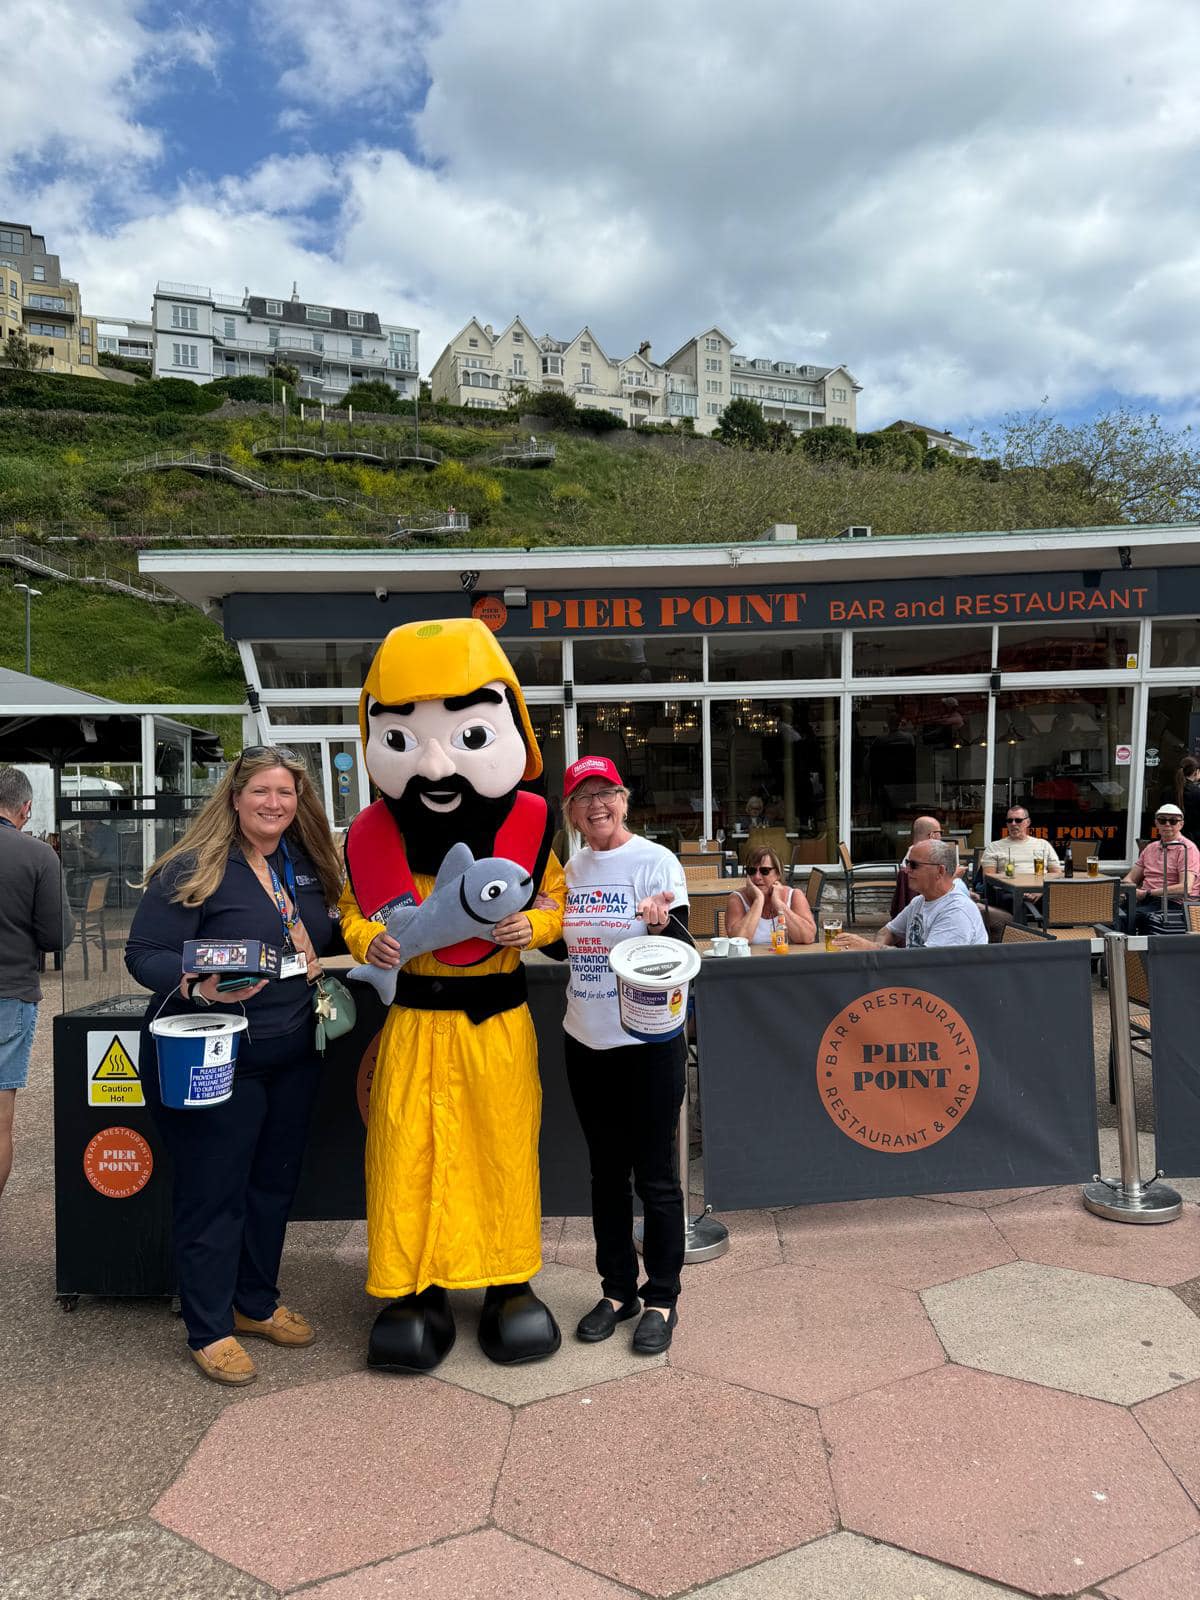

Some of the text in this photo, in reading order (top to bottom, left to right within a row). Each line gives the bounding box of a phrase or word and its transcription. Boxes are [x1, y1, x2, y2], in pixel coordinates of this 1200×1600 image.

[829, 588, 1149, 621] BAR and RESTAURANT
[530, 593, 807, 630] PIER POINT
[1056, 826, 1118, 839] POINT
[567, 891, 628, 905] NATIONAL
[577, 937, 602, 945] WE'RE
[568, 945, 609, 954] CELEBRATIN
[569, 954, 609, 964] THE NATION
[580, 973, 602, 982] DISH!
[606, 988, 617, 998] sol
[825, 993, 971, 1066] BAR & RESTAURANT
[861, 1041, 942, 1064] PIER
[852, 1068, 952, 1092] POINT
[101, 1085, 133, 1093] Caution
[110, 1094, 125, 1102] Hot
[825, 1083, 972, 1147] RESTAURANT & BAR
[87, 1142, 98, 1159] BAR
[104, 1128, 150, 1158] RESTAURANT
[103, 1149, 137, 1160] PIER
[98, 1161, 142, 1172] POINT
[87, 1167, 131, 1196] RESTAURANT
[139, 1169, 150, 1186] BAR
